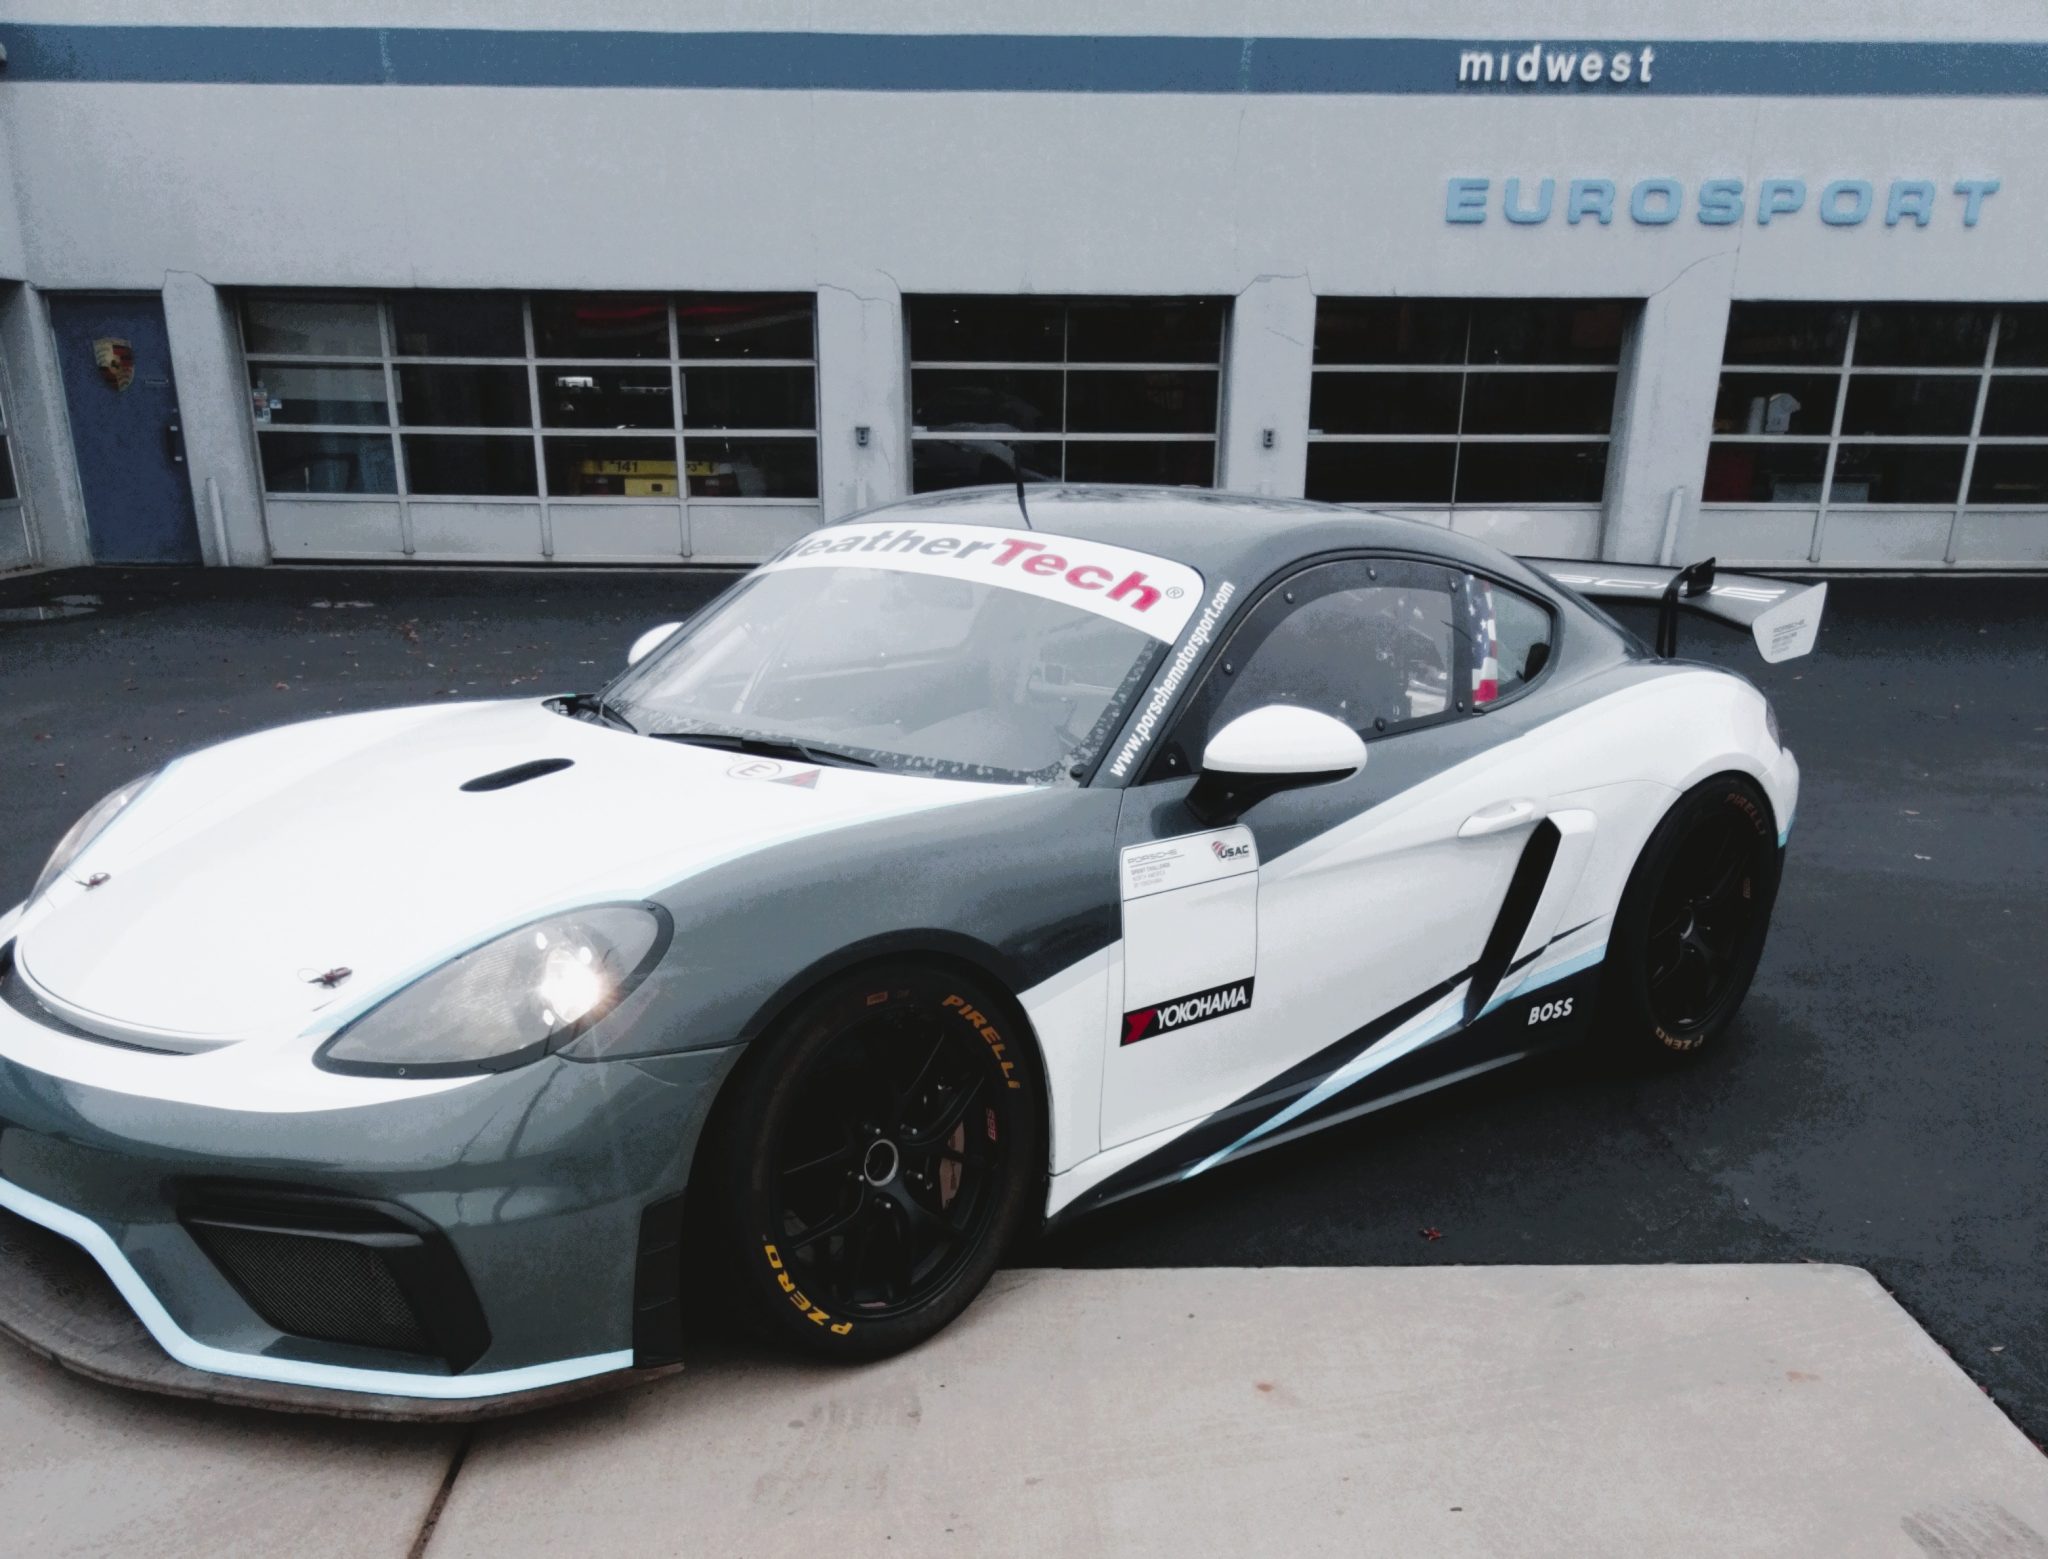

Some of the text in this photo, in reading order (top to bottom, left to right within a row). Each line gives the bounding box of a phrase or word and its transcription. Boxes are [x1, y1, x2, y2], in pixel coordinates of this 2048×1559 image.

[1459, 45, 1654, 84] midwest
[1445, 177, 2001, 226] EUROSPORT
[1110, 581, 1236, 777] www.porschemotorsport.com
[1727, 792, 1766, 835] PIRELLI
[1220, 845, 1249, 859] USAC
[1156, 985, 1247, 1030] YOKOHAMA
[1528, 997, 1574, 1026] BOSS
[942, 994, 1020, 1089] PIRELLI
[763, 1244, 834, 1326] ZERO
